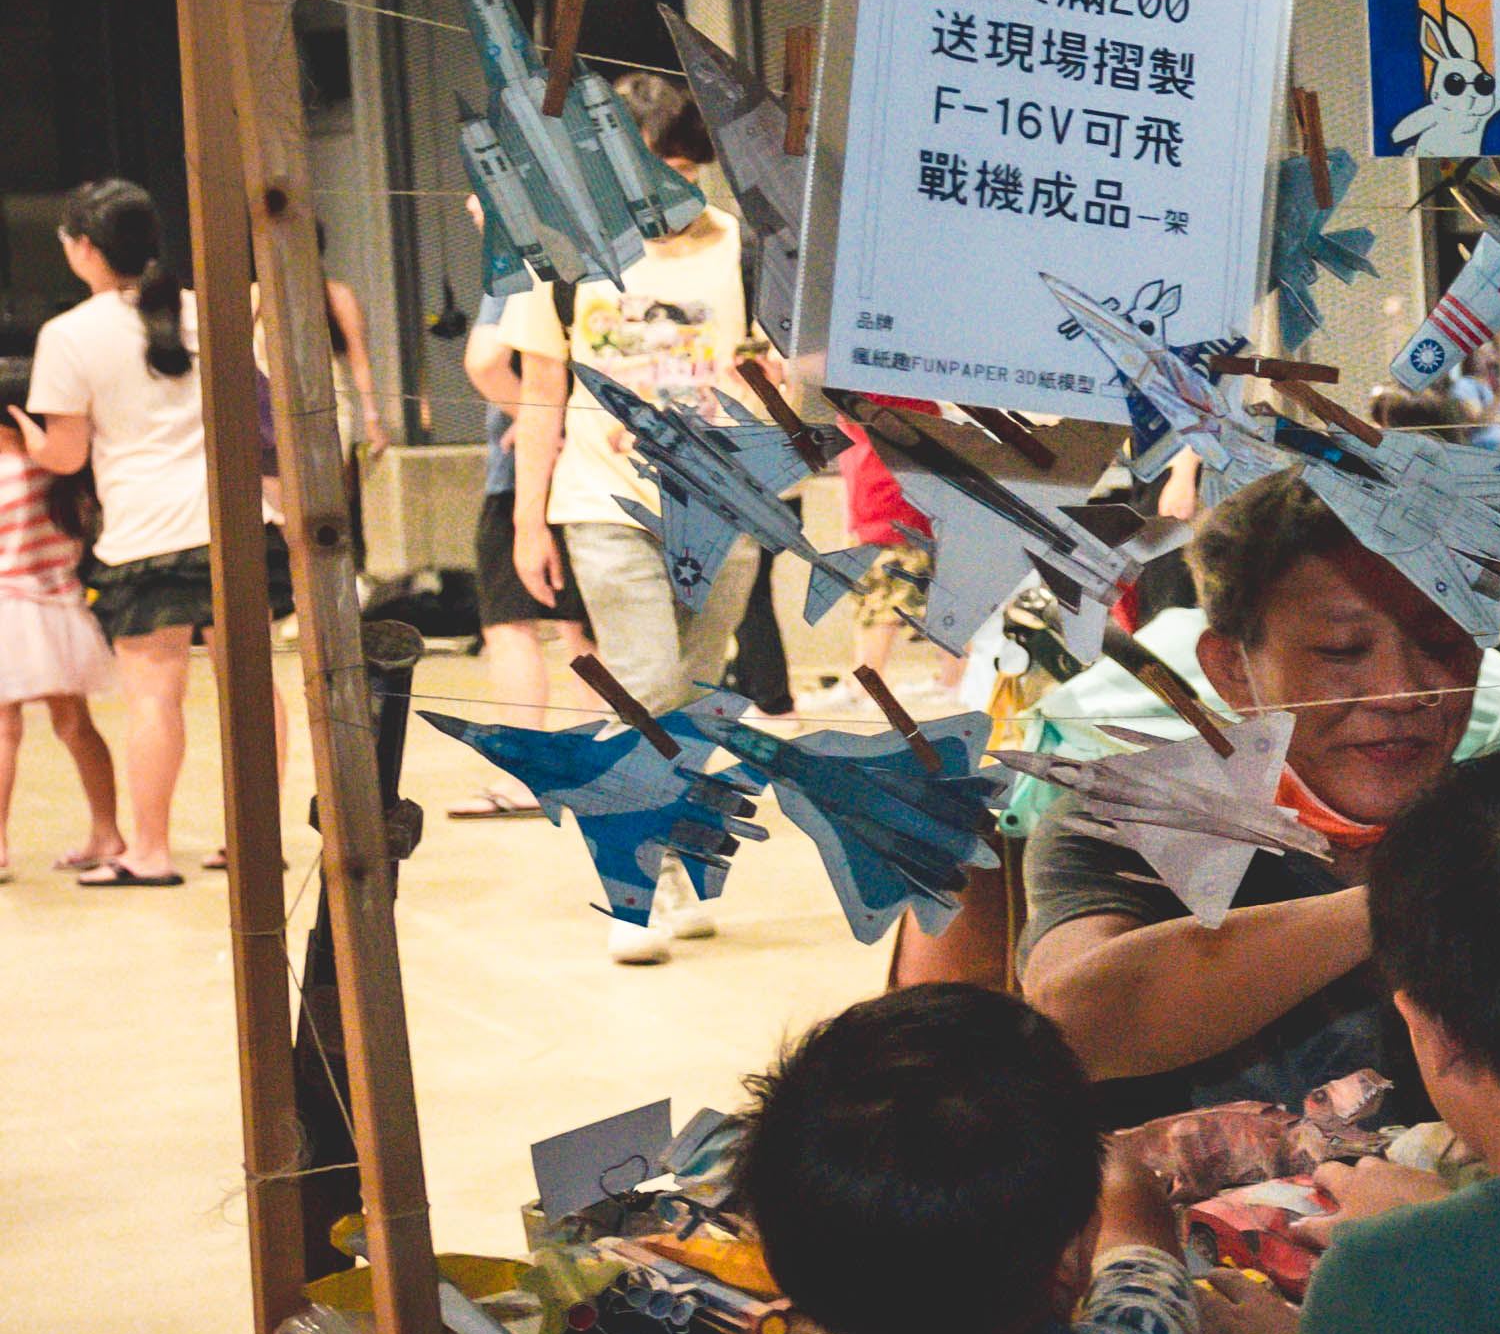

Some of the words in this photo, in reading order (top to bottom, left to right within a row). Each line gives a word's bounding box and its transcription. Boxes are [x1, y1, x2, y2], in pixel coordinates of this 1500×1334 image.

[930, 9, 1197, 100] 送現場摺製
[933, 87, 1185, 169] F-16V可飛
[918, 149, 1190, 236] 戰機成品一架
[856, 311, 895, 332] 品牌
